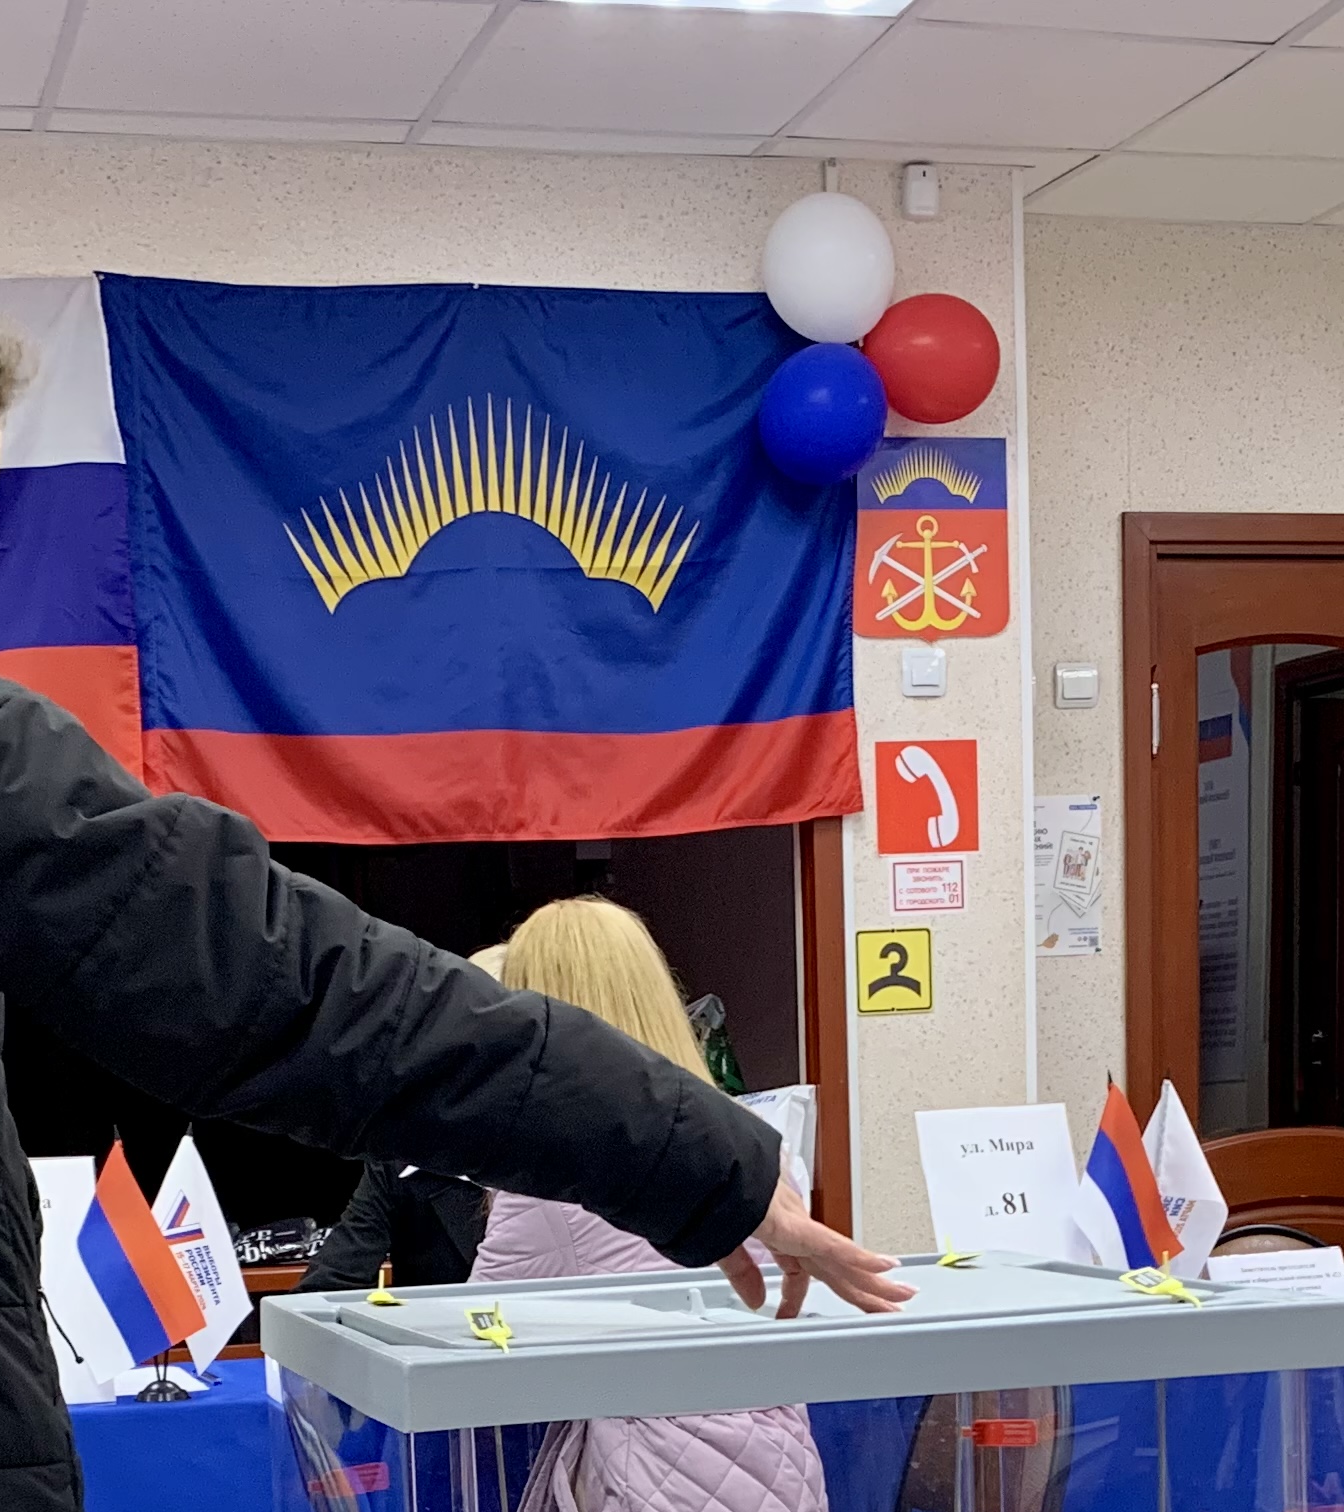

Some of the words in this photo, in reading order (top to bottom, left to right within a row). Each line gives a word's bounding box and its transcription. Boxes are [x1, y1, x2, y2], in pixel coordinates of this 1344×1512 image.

[942, 882, 958, 893] 112
[949, 894, 959, 904] 01
[960, 1143, 984, 1158] ул.
[988, 1138, 1035, 1155] Мира
[984, 1205, 999, 1217] д.
[1002, 1192, 1030, 1215] 81
[185, 1249, 206, 1286] РОССИИ
[194, 1247, 221, 1306] ПРЕЗИДЕНТА
[202, 1245, 222, 1286] ВЫБОРЫ
